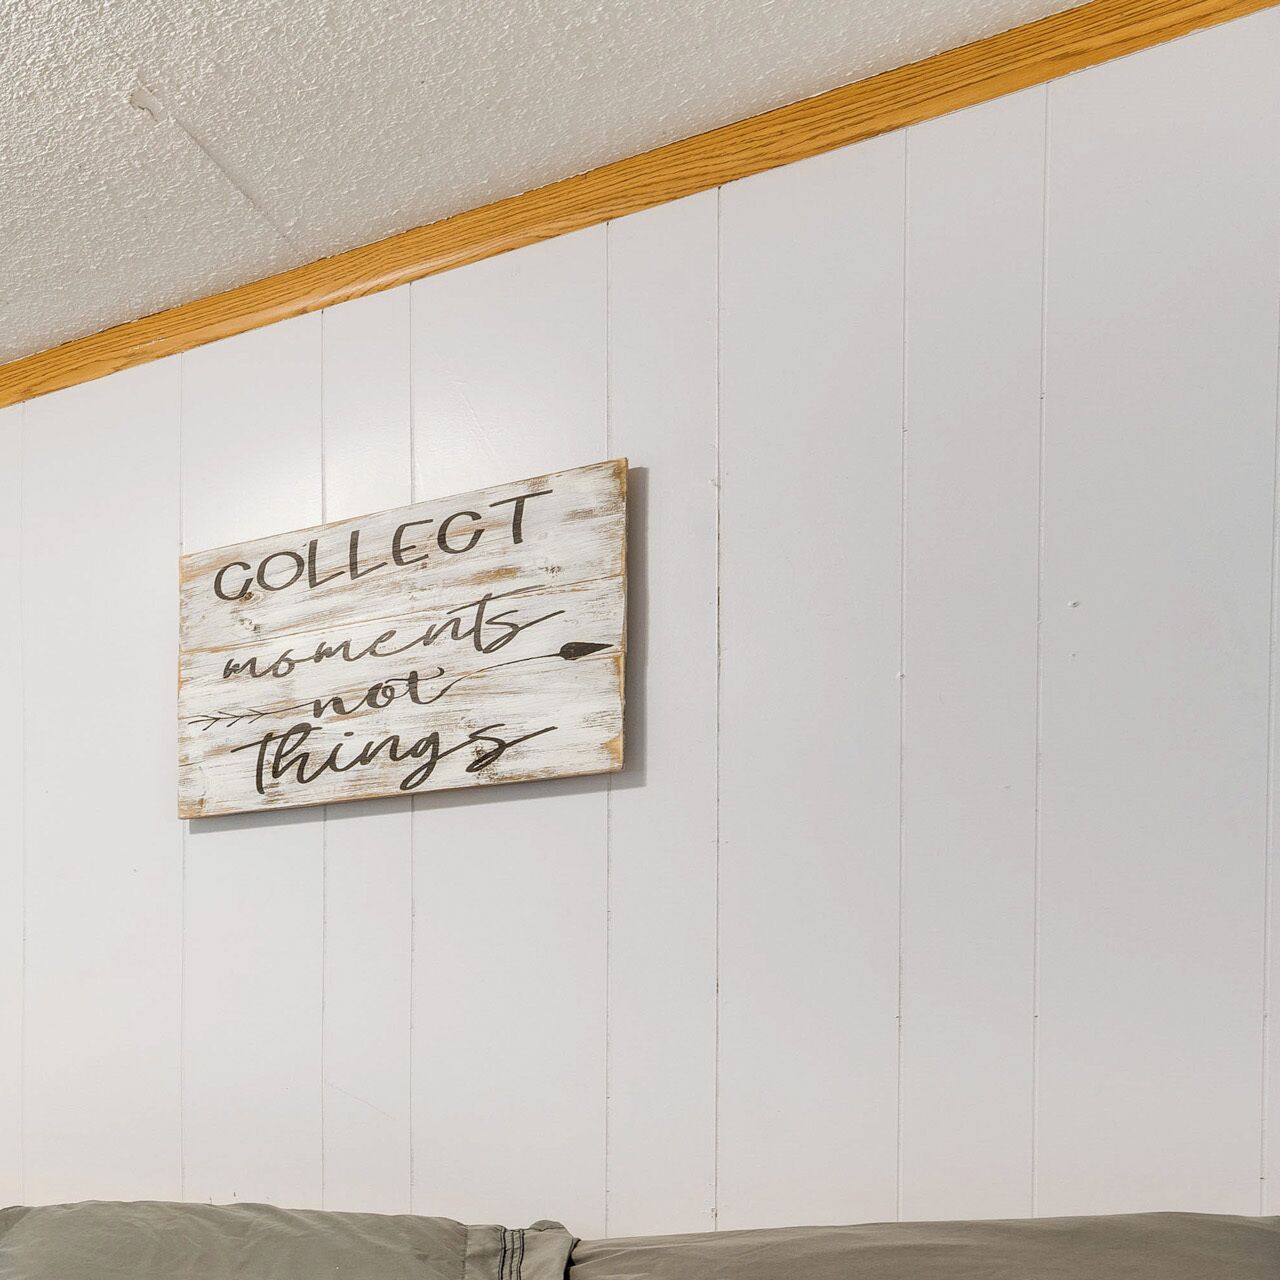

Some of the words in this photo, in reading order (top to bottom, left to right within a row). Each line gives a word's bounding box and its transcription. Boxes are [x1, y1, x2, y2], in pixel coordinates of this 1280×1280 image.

[214, 489, 553, 600] COLLECT
[222, 585, 565, 679] moments
[313, 667, 445, 719] not
